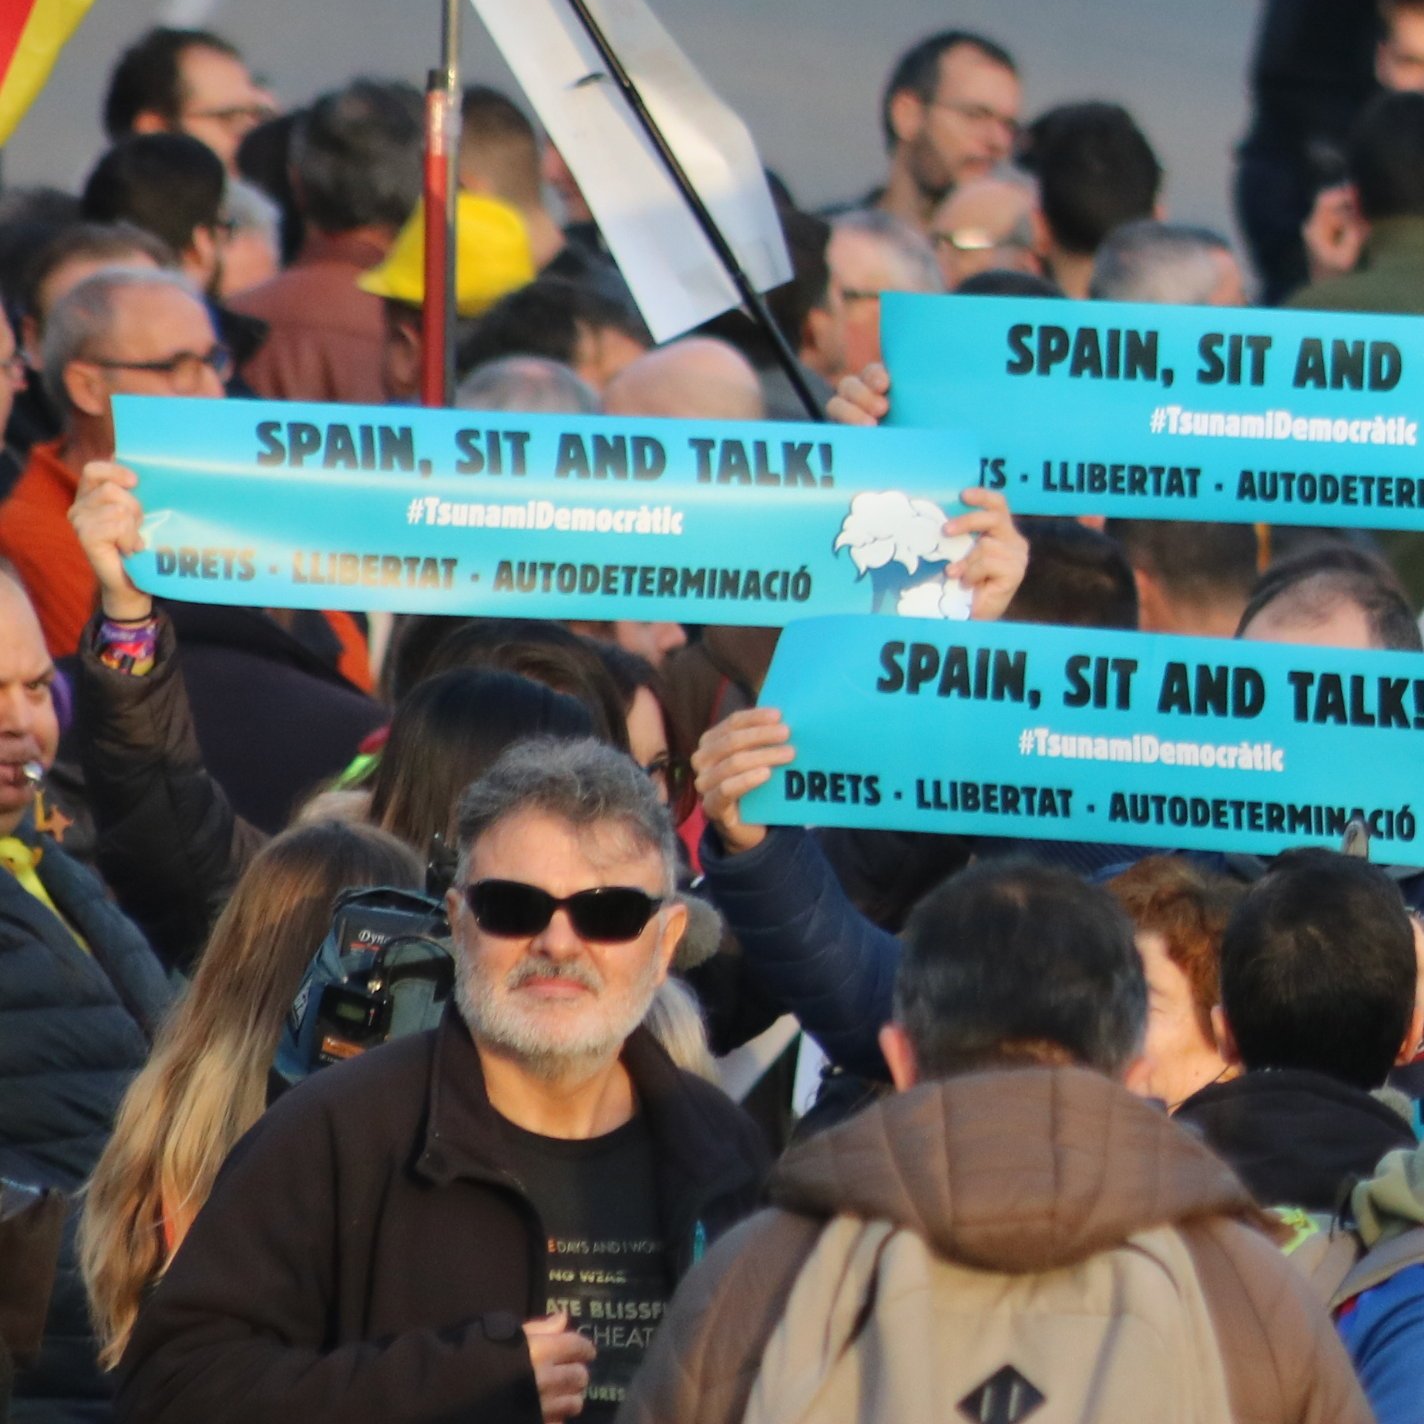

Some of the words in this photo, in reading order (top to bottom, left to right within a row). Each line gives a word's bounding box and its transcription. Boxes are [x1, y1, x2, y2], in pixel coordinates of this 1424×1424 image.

[1006, 323, 1175, 388] SPAIN,
[1196, 332, 1273, 387] SIT
[1292, 337, 1403, 392] AND
[255, 420, 432, 474] SPAIN,
[454, 427, 531, 475] SIT
[555, 432, 667, 479] AND
[687, 437, 834, 486] TALK!
[1042, 460, 1202, 498] LLIBERTAT
[155, 547, 257, 583] DRETS
[291, 550, 458, 592] LLIBERTAT
[495, 559, 812, 603] AUTODETERMINACIÓ
[876, 640, 1042, 710] SPAIN,
[1063, 654, 1138, 711] SIT
[1157, 661, 1266, 719] AND
[784, 769, 882, 807] DRETS
[915, 778, 1073, 819] LLIBERTAT
